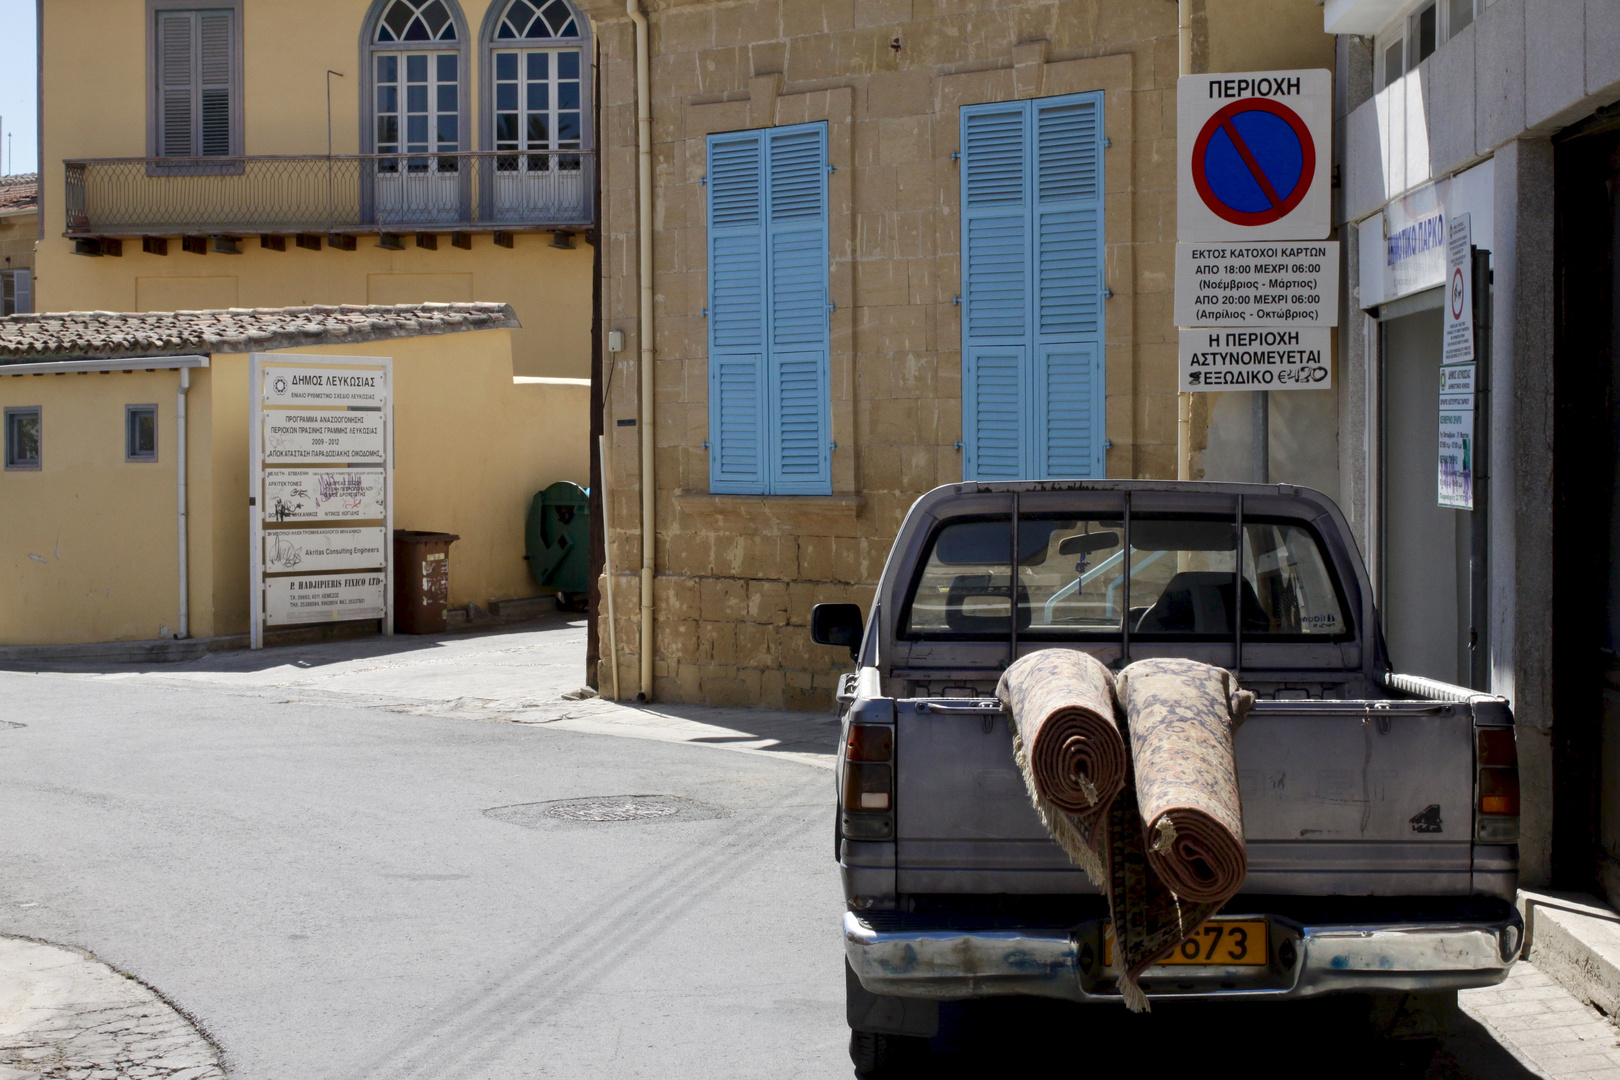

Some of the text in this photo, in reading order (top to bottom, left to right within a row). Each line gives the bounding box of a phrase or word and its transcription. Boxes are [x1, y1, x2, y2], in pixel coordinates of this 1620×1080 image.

[1209, 77, 1301, 99] ΠΕΡΙΟΧΗ
[1191, 247, 1326, 260] ΕΚΤΟΣ ΚΑΤΟΧΟΙ ΚΑΡΤΩΝ
[1195, 263, 1321, 275] ΑΠΟ 18:00 ΜΕΧΡΙ 06:00
[1199, 279, 1259, 291] (Νοέμβριος
[1268, 278, 1317, 290] Μάρτιος)
[1195, 294, 1320, 305] ΑΠΟ 20:00 ΜΕΧΡΙ 06:00
[1196, 308, 1246, 321] (Απρίλιος
[1256, 308, 1319, 321] Οκτώβριος)
[1209, 332, 1299, 347] Η ΠΕΡΙΟΧΗ
[1190, 350, 1321, 366] ΑΣΤΥΝΟΜΕΥΕΤΑΙ
[291, 375, 375, 388] ΔΗΜΟΣ ΛΕΥΚΩΣΙΑΣ
[1204, 370, 1274, 385] ΕΞΩΔΙΚΟ
[285, 415, 318, 423] ΠΡΟΓΡΑΜΜΑ
[271, 426, 297, 434] ΠΕΡΙΟΧΩΝ
[349, 427, 378, 435] ΛΕΥΚΩΣΙΑΣ
[325, 548, 353, 556] Consulting
[353, 547, 379, 555] Engineers
[290, 577, 381, 590] P. HADJIPIERIS FIXICO LTD
